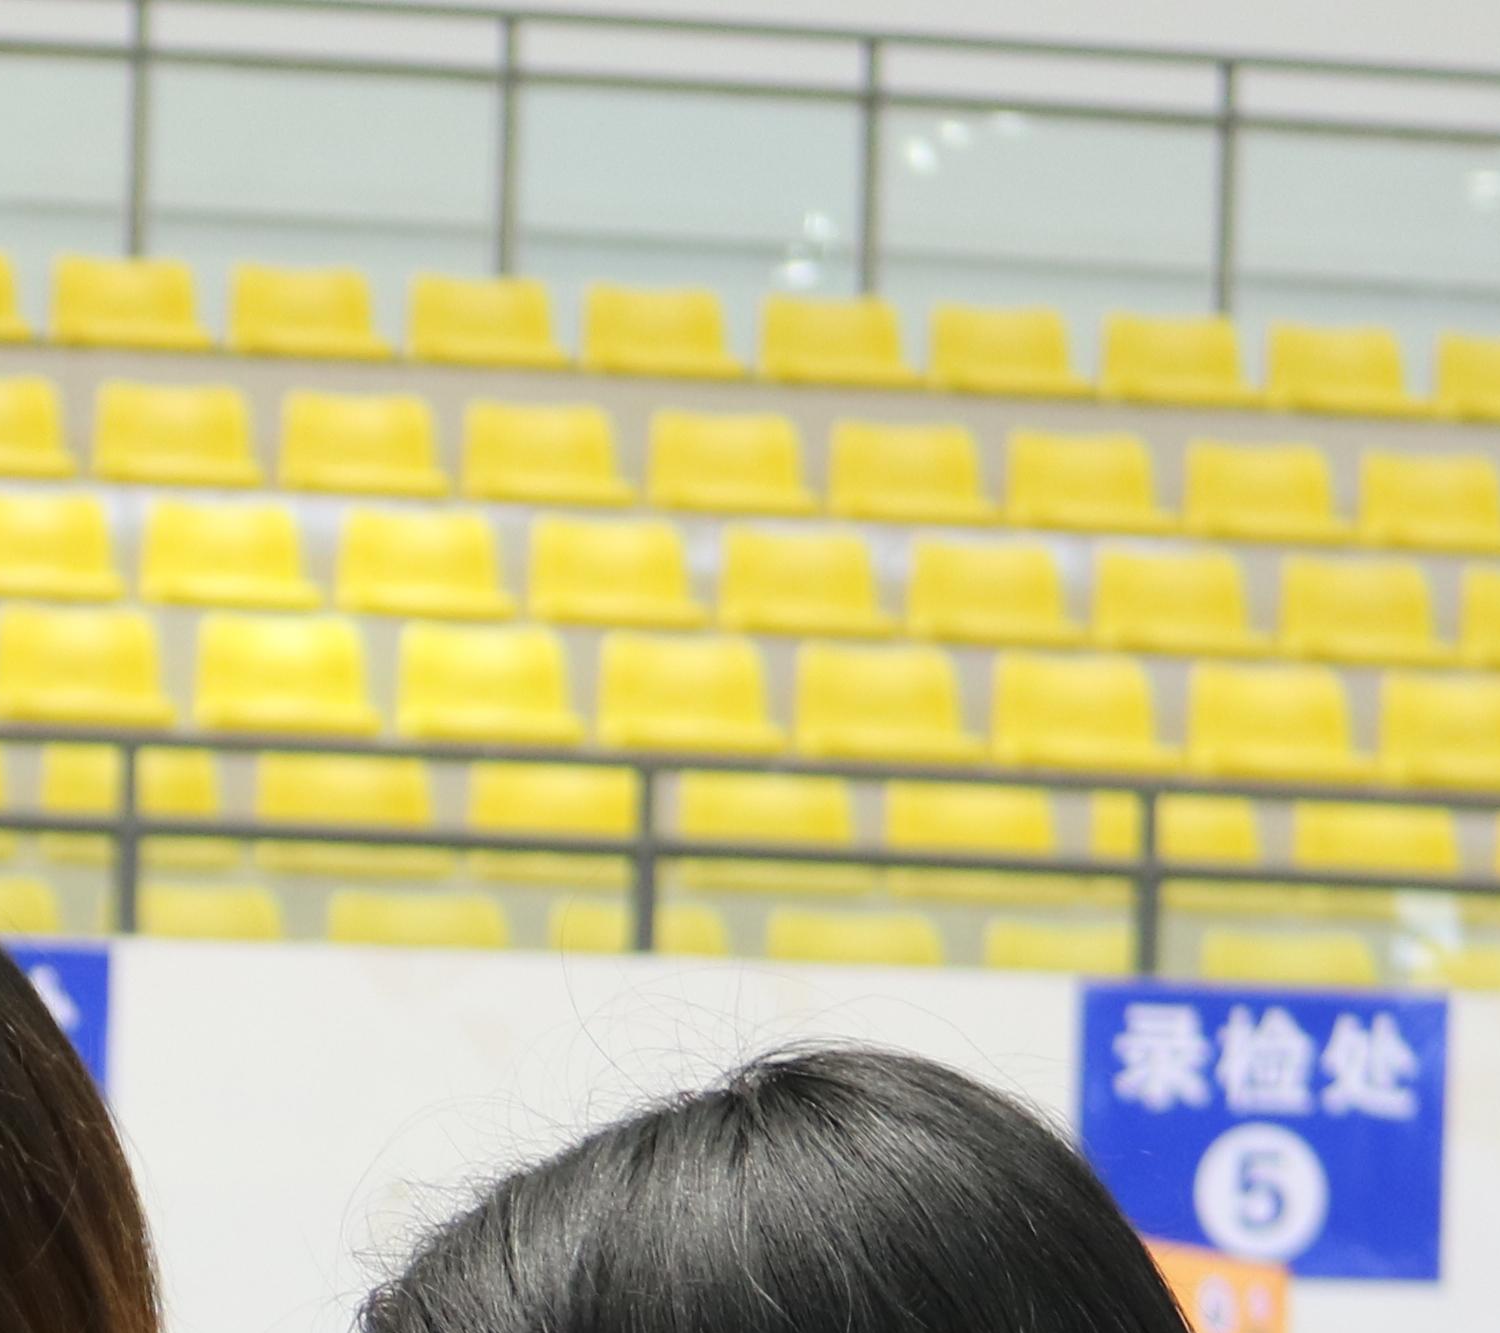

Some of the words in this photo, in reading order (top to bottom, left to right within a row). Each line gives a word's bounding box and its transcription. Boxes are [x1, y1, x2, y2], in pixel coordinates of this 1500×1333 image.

[1112, 1002, 1419, 1121] 录检处
[1237, 1150, 1284, 1229] 5
